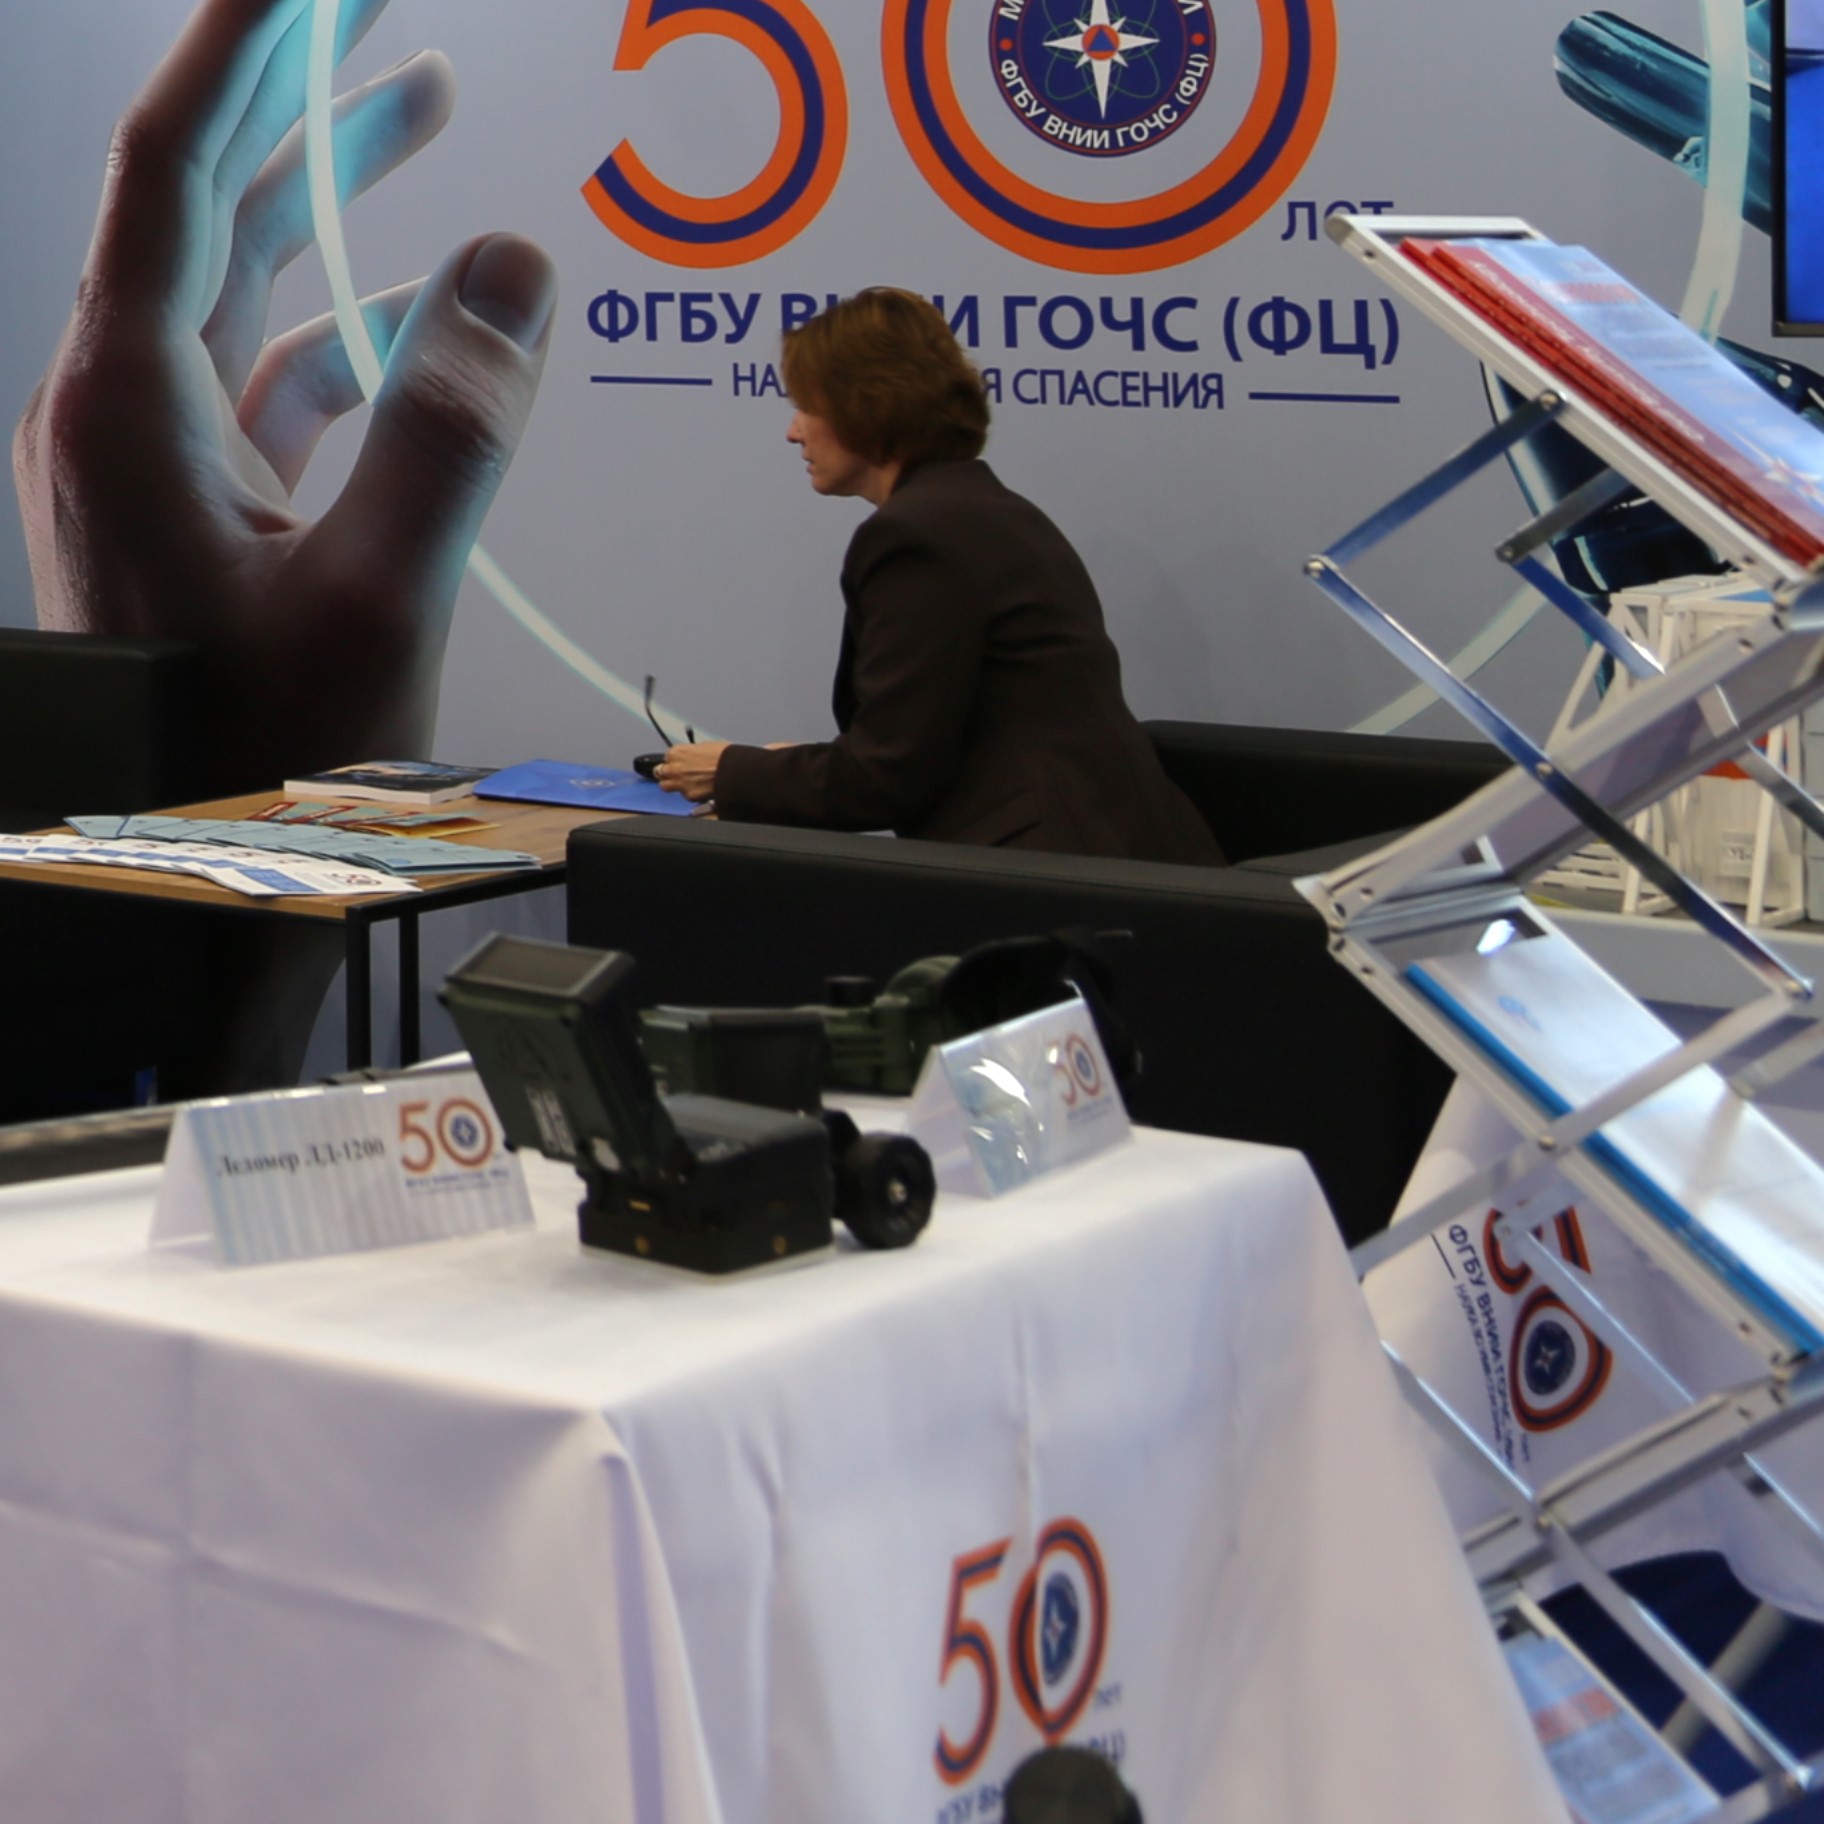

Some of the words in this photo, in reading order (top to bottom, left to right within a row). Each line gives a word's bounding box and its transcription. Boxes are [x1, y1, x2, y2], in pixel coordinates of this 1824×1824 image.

[1001, 59, 1046, 118] ФГБУ
[1043, 115, 1110, 149] ВНИИ
[1116, 104, 1178, 147] ГОЧС
[1174, 53, 1209, 105] (ФЦ)
[586, 289, 762, 346] ФГБУ
[1003, 295, 1199, 353] ГОЧС
[1222, 295, 1400, 369] (ФЦ)
[1012, 368, 1224, 409] СПАСЕНИЯ
[1449, 1223, 1487, 1288] ФГБУ
